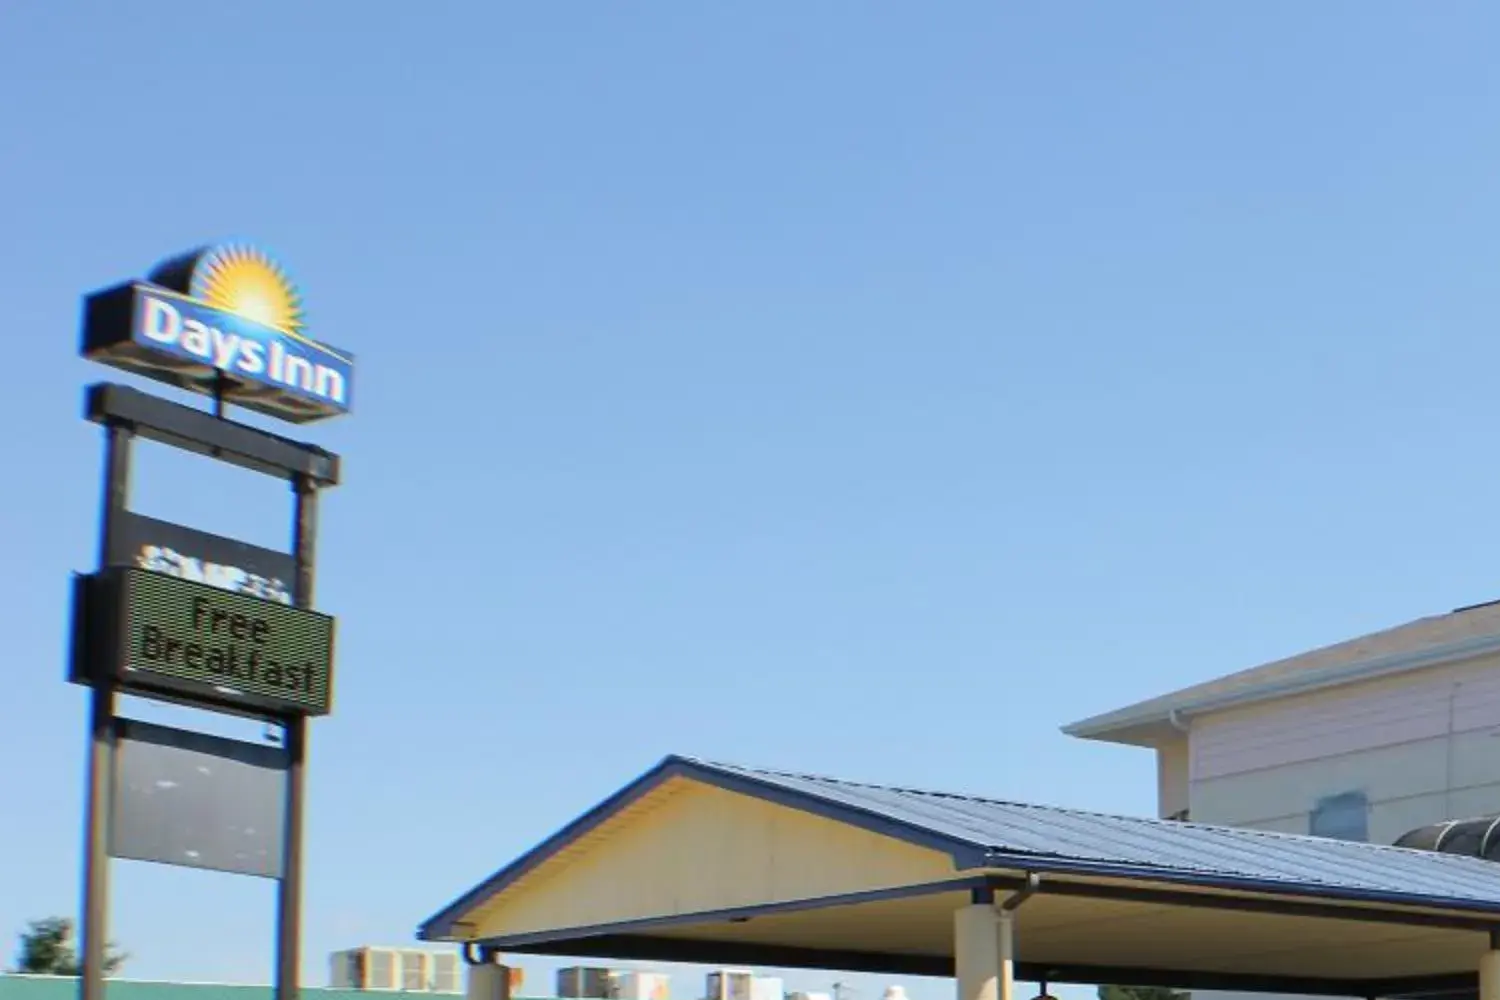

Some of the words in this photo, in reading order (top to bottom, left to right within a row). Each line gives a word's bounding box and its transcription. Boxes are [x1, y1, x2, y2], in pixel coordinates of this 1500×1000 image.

[143, 295, 265, 371] Days
[268, 340, 345, 402] Inn
[193, 597, 270, 644] Free
[142, 624, 315, 693] Breakfast
